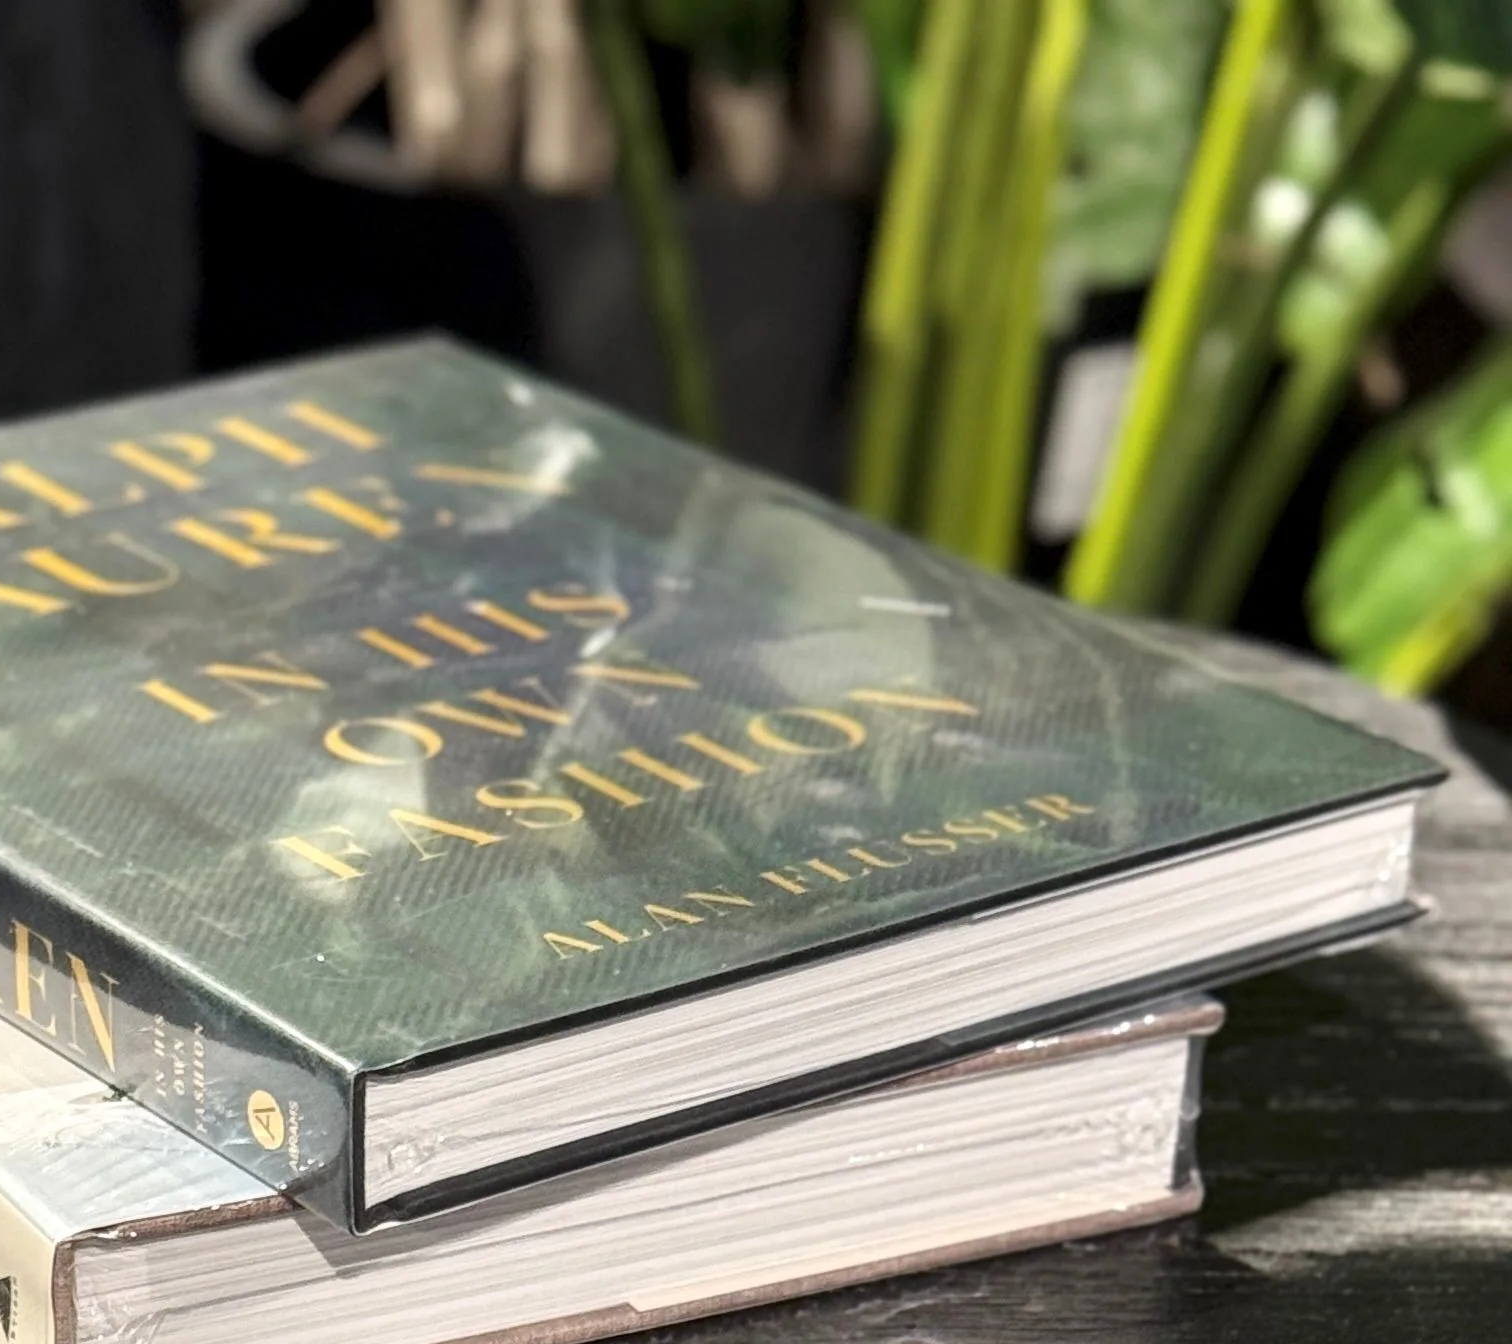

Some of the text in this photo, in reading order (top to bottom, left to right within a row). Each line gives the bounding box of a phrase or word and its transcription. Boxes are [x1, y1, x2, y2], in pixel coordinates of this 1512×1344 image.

[140, 584, 631, 723] IN HIS
[322, 660, 702, 767] OWN
[269, 677, 980, 882] FASHION
[541, 791, 1096, 961] ALAN FLUSSER
[153, 1012, 168, 1058] HIS
[192, 1021, 209, 1134] FASHION
[288, 1099, 304, 1174] ABRAMS
